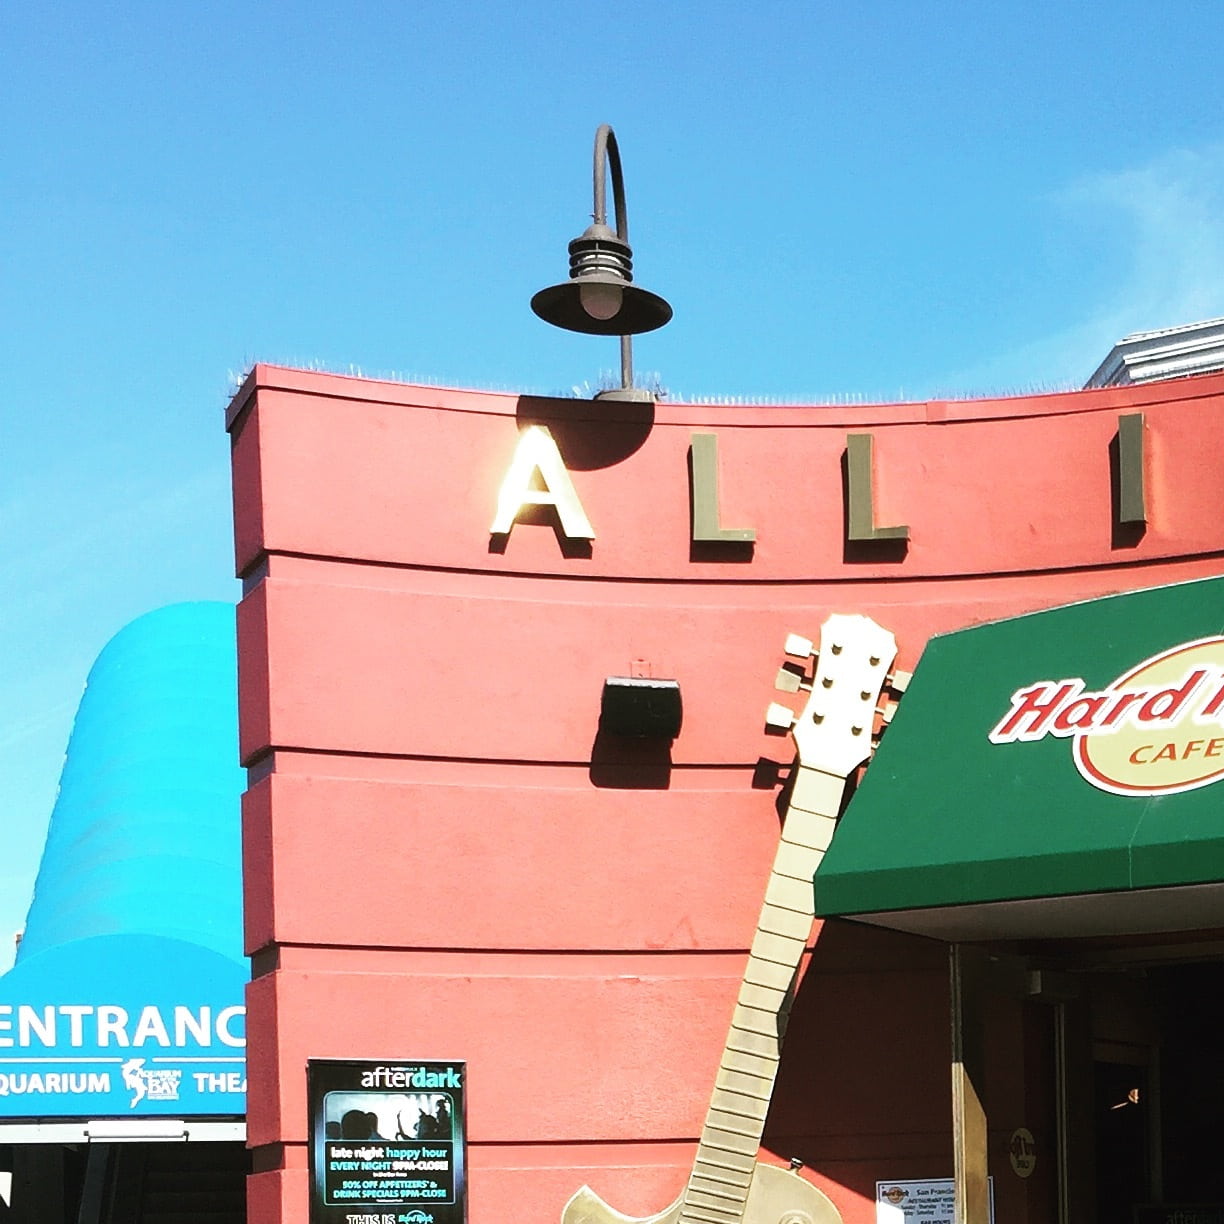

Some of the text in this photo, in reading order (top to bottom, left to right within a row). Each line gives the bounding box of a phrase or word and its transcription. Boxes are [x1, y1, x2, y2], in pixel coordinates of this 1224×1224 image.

[489, 424, 911, 544] ALL
[990, 670, 1208, 743] Hard
[331, 1147, 448, 1161] late night happy hour
[330, 1161, 360, 1171] EVERY
[361, 1161, 391, 1171] NIGHT
[362, 1180, 378, 1189] OFF
